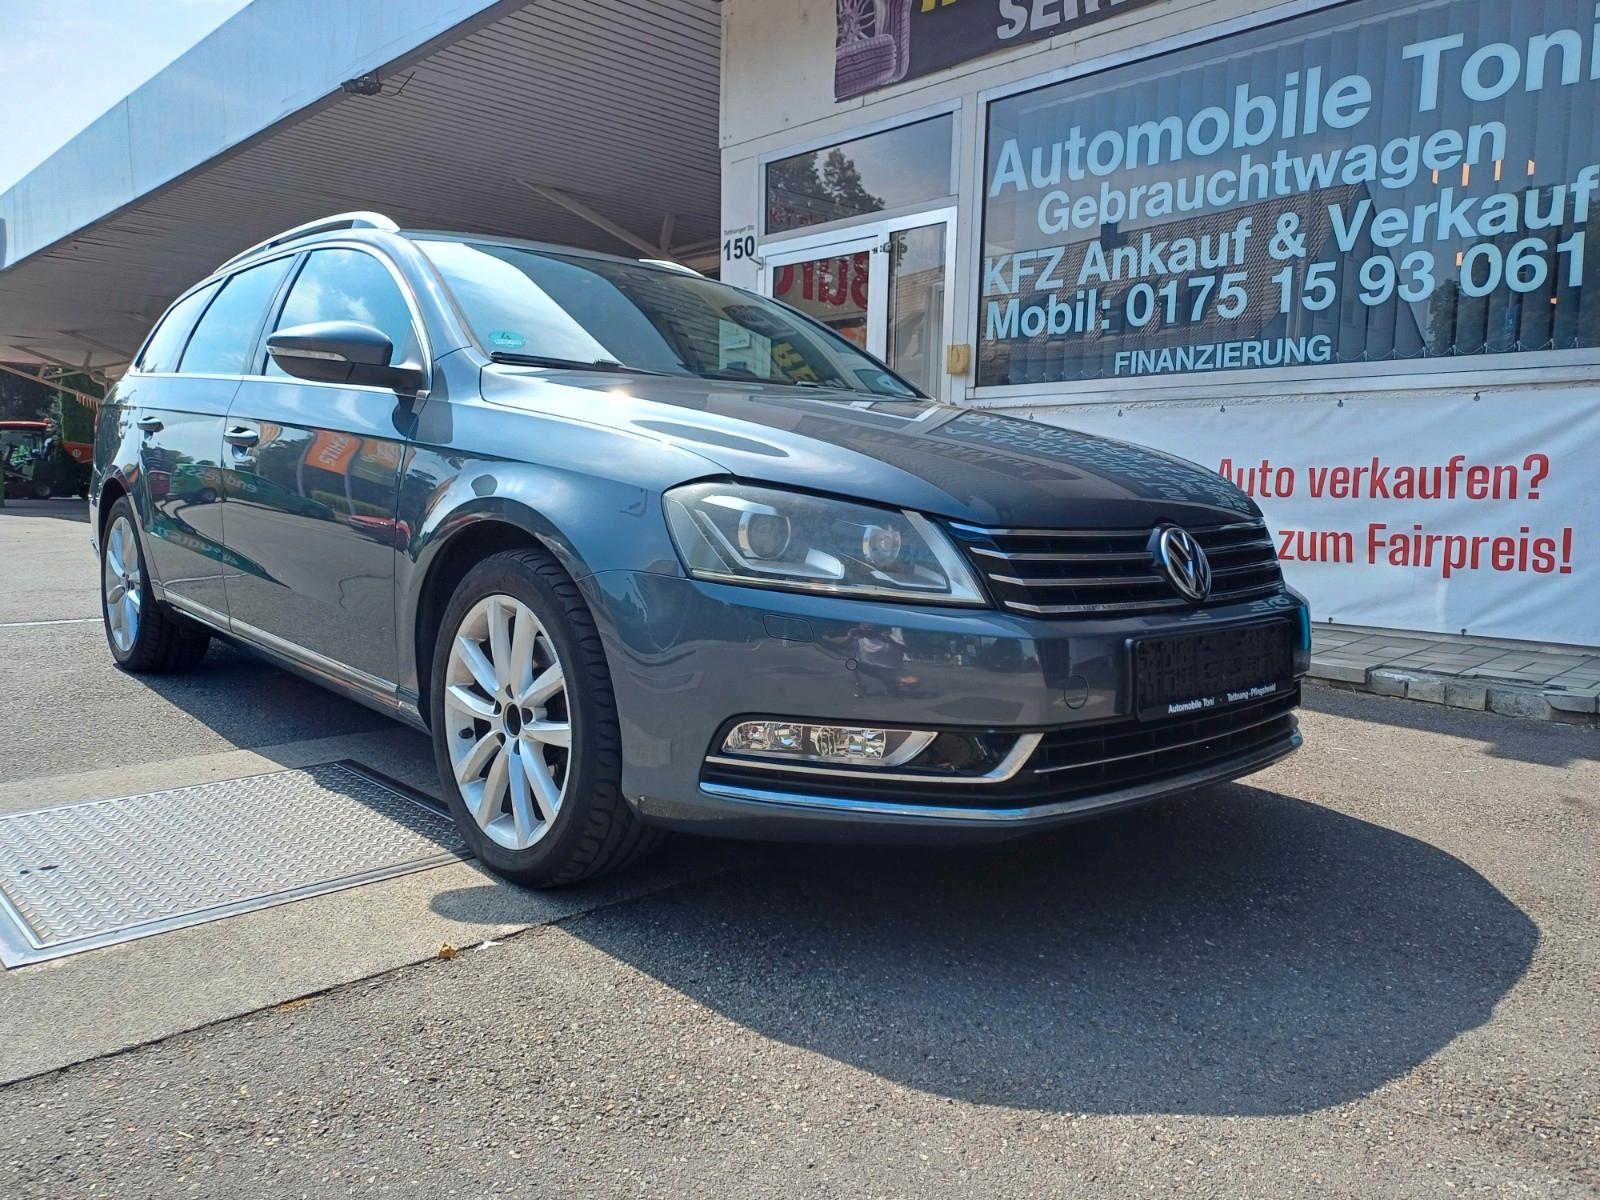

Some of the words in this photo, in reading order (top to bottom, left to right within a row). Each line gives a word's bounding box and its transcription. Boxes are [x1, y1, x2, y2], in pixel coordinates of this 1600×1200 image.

[987, 66, 1372, 198] Automobile
[1402, 2, 1600, 113] Toni
[1037, 121, 1507, 236] Gebrauchtwagen
[723, 236, 755, 261] 150
[982, 246, 1066, 297] KFZ
[1077, 217, 1253, 286] Ankauf
[1268, 212, 1307, 261] &
[1328, 165, 1600, 253] Verkauf
[985, 288, 1110, 341] Mobil:
[1126, 271, 1249, 327] 0175
[1271, 261, 1338, 314] 15
[1358, 251, 1436, 306] 93
[1459, 231, 1586, 298] 061
[1113, 334, 1332, 375] FINANZIERUNG
[1218, 458, 1294, 497] Auto
[1309, 453, 1549, 500] verkaufen?
[1278, 529, 1353, 562] zum
[1368, 523, 1573, 578] Fairpreis!
[1168, 699, 1202, 714] Automobile
[1203, 697, 1215, 707] Toni
